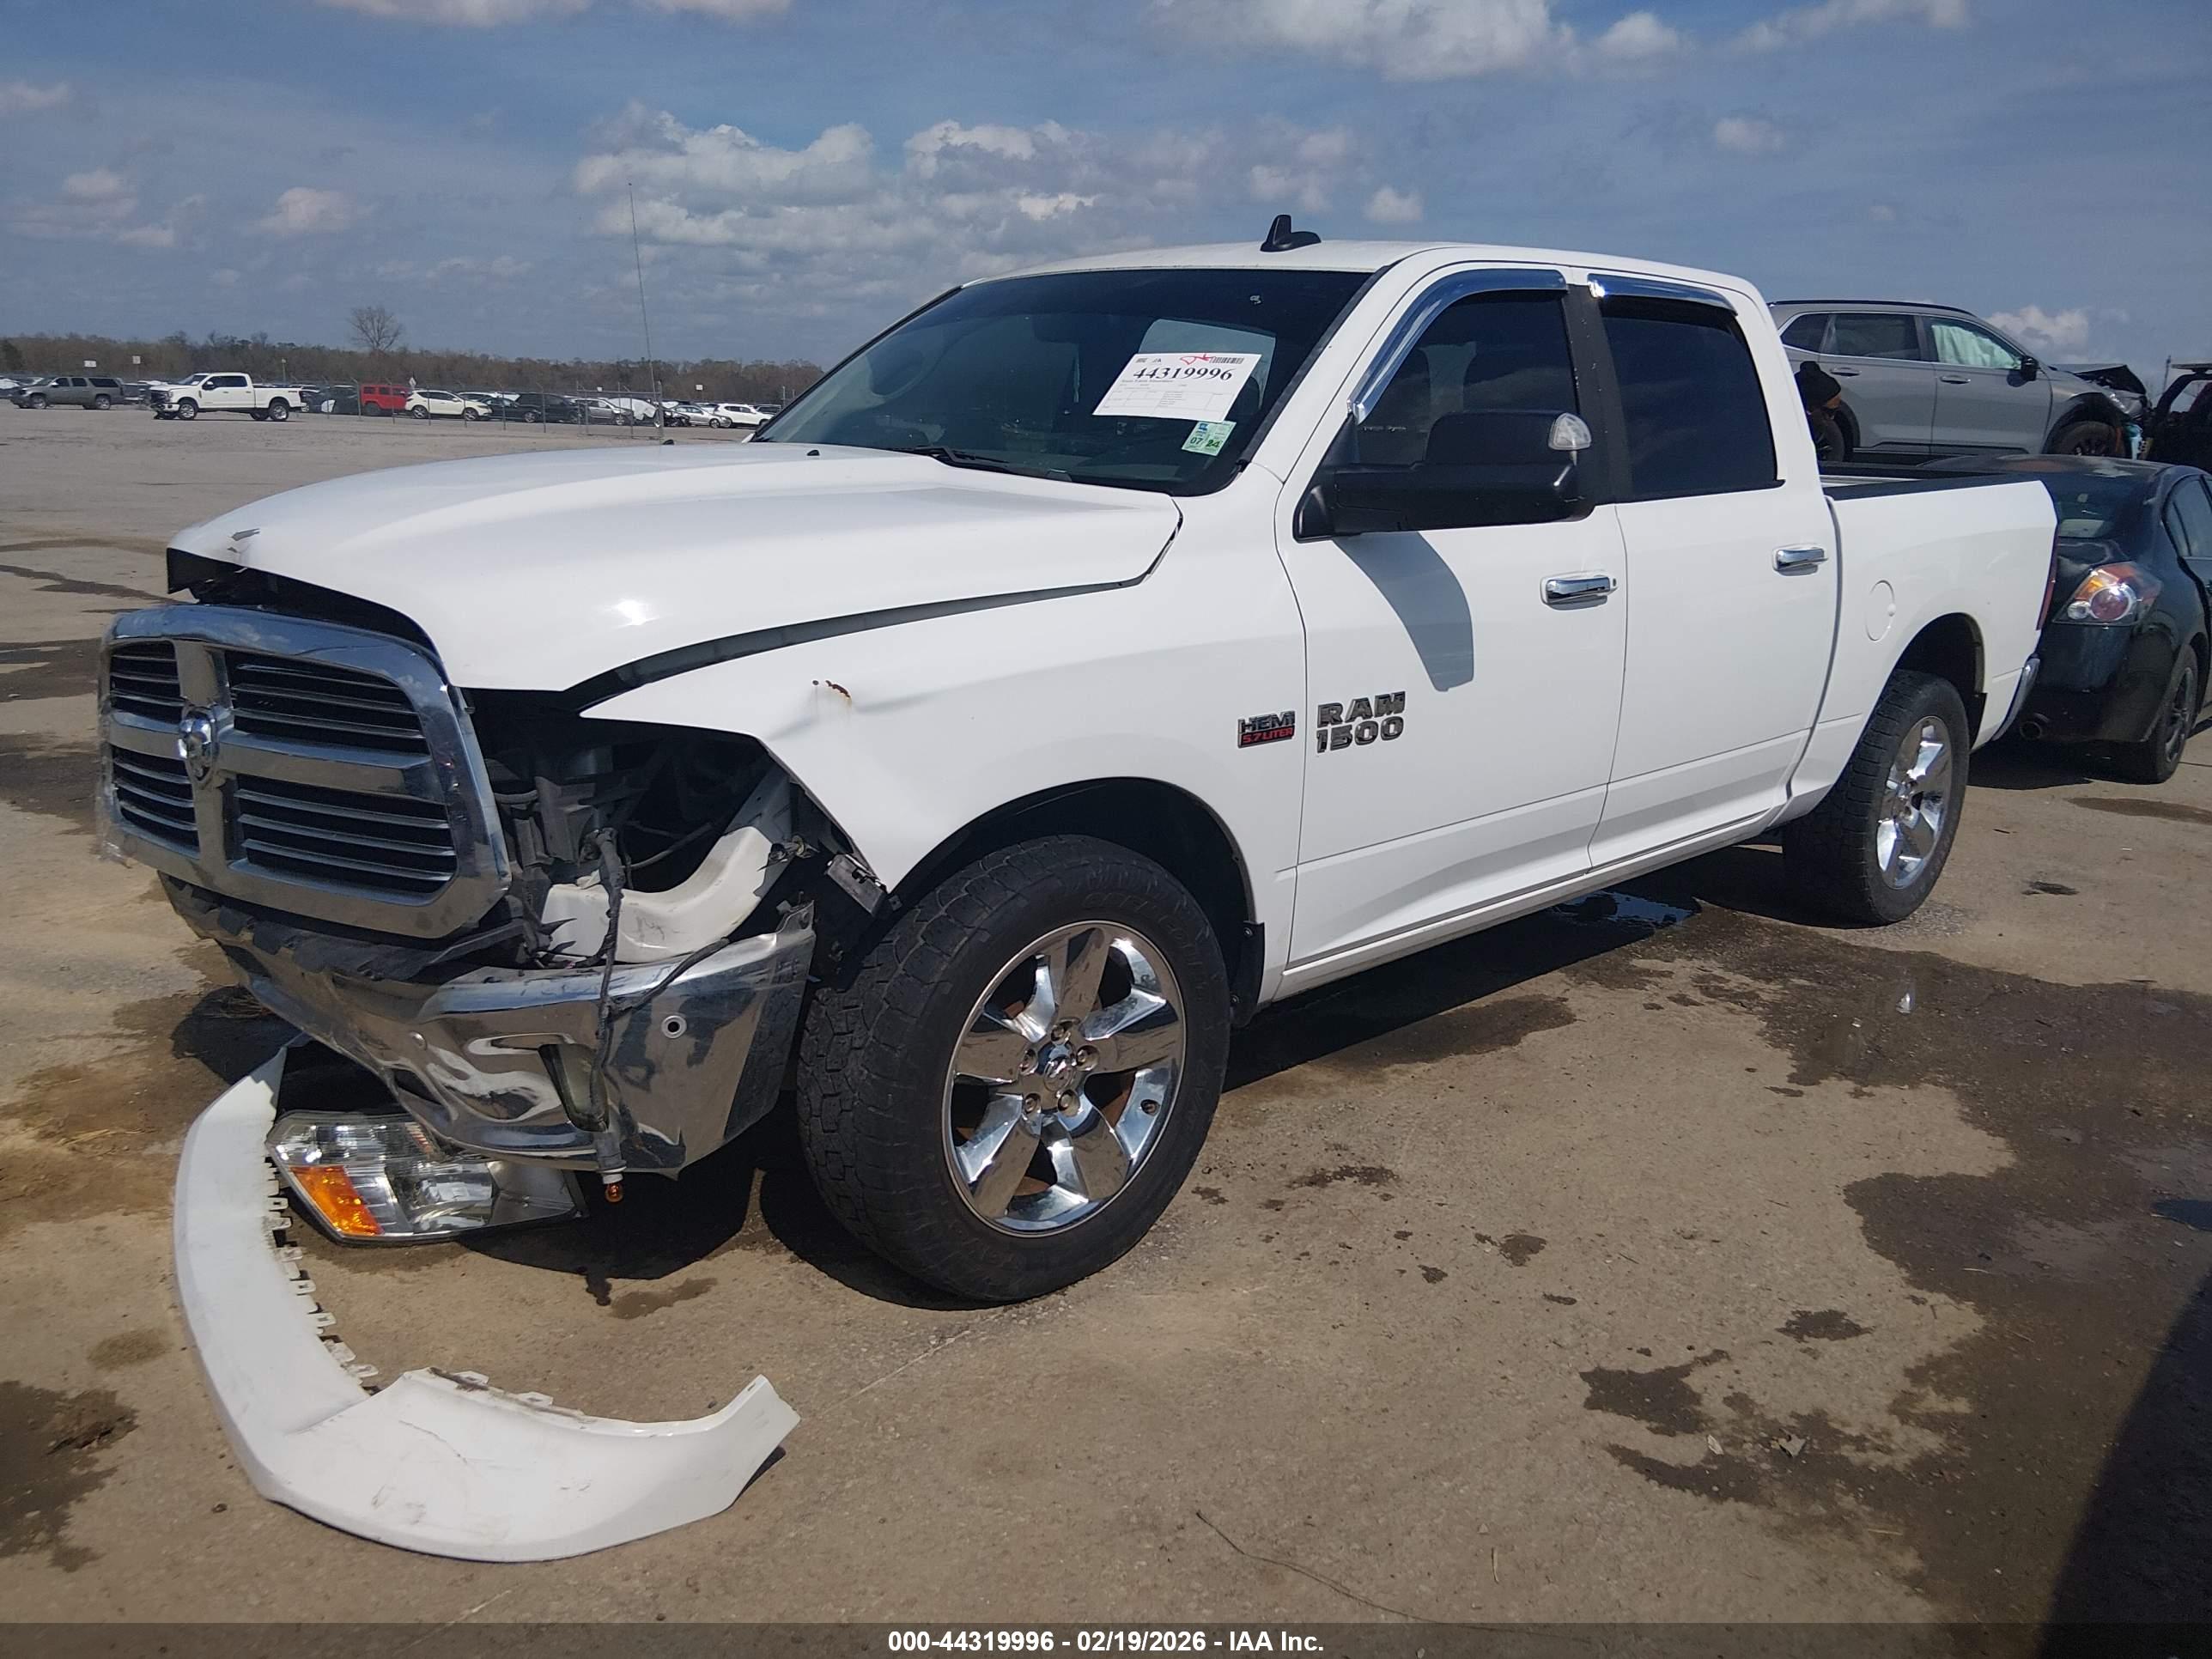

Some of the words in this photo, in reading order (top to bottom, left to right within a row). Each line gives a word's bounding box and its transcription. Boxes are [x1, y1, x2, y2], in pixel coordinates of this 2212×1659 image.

[1133, 367, 1237, 381] 44319996
[1316, 690, 1406, 728] RAM
[1237, 711, 1295, 733] HEMI
[1243, 732, 1262, 743] 5.7
[1262, 727, 1293, 740] LITER
[1316, 716, 1404, 754] 1500
